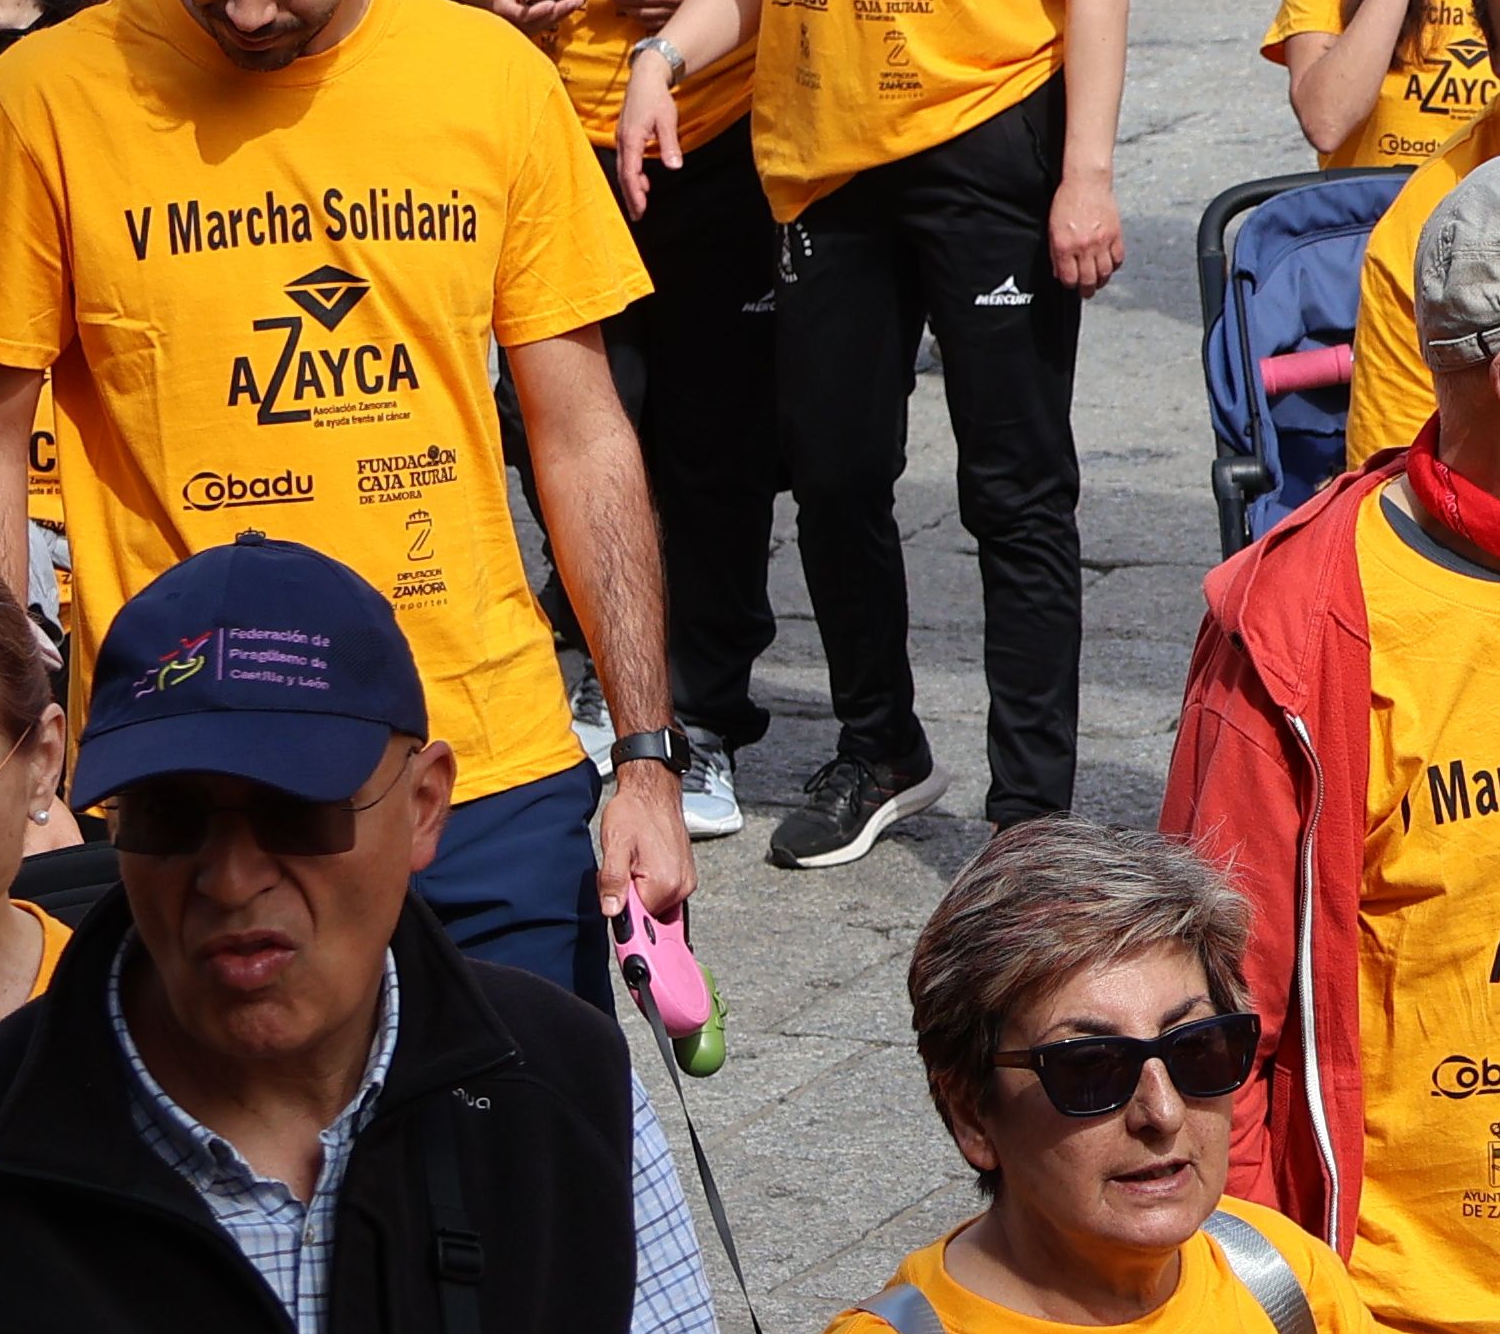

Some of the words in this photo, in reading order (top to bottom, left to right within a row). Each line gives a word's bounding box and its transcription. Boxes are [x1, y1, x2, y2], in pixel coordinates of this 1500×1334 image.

[125, 207, 152, 261] V
[167, 192, 312, 255] Marcha
[322, 188, 478, 244] Solidaria
[975, 291, 1034, 307] MERCURY
[227, 316, 419, 426] AZAYCA
[182, 469, 315, 512] Cobadu
[357, 472, 403, 494] CAJA
[408, 467, 457, 489] RURAL
[359, 493, 376, 505] DE
[379, 490, 423, 504] ZAMORA
[393, 582, 448, 599] ZAMORA
[229, 626, 308, 645] Federación
[311, 633, 331, 647] de
[229, 648, 304, 669] Piragüismo
[310, 656, 328, 669] de
[286, 675, 297, 689] y
[1462, 1203, 1482, 1218] DE
